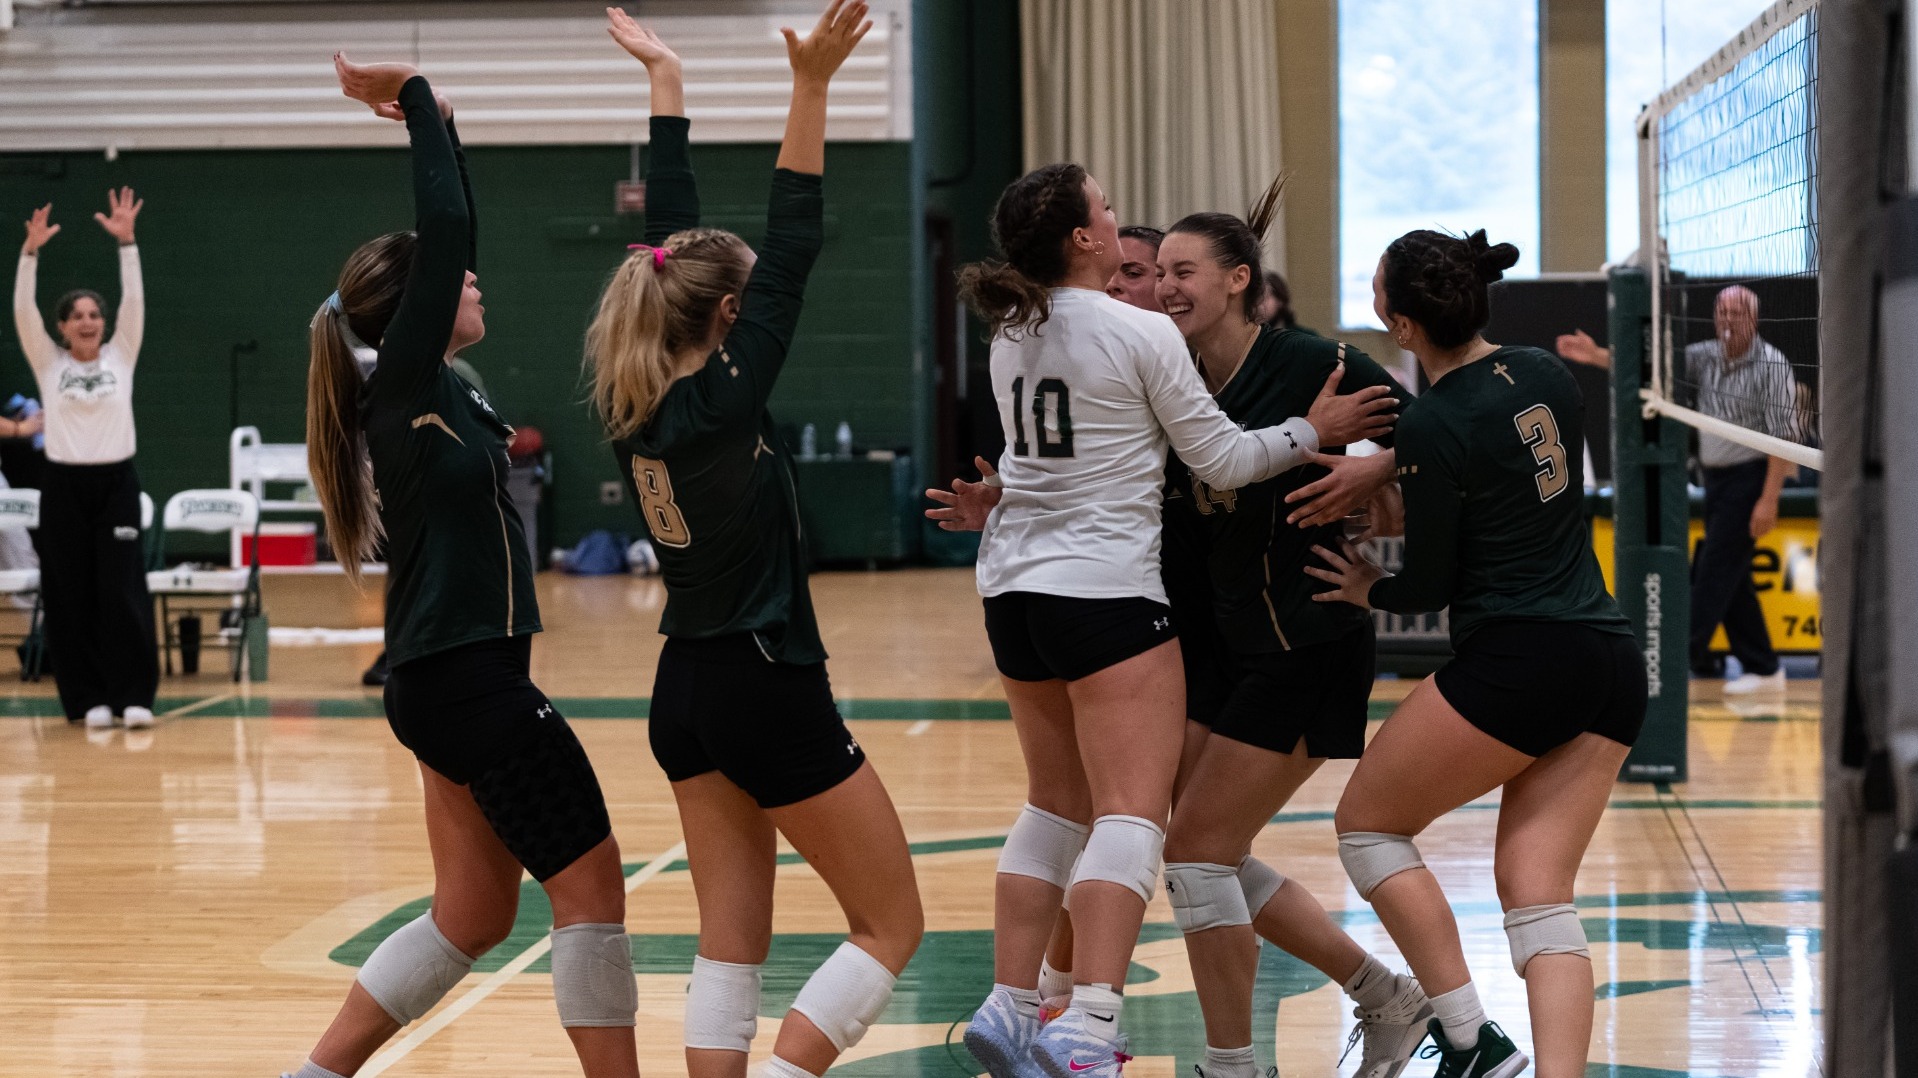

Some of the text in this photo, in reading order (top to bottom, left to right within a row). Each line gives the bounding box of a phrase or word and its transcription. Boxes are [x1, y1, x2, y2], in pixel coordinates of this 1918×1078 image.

[1011, 376, 1075, 459] 10
[1513, 403, 1569, 503] 3
[632, 453, 692, 549] 8
[1643, 572, 1662, 628] sports
[1782, 615, 1824, 638] 74
